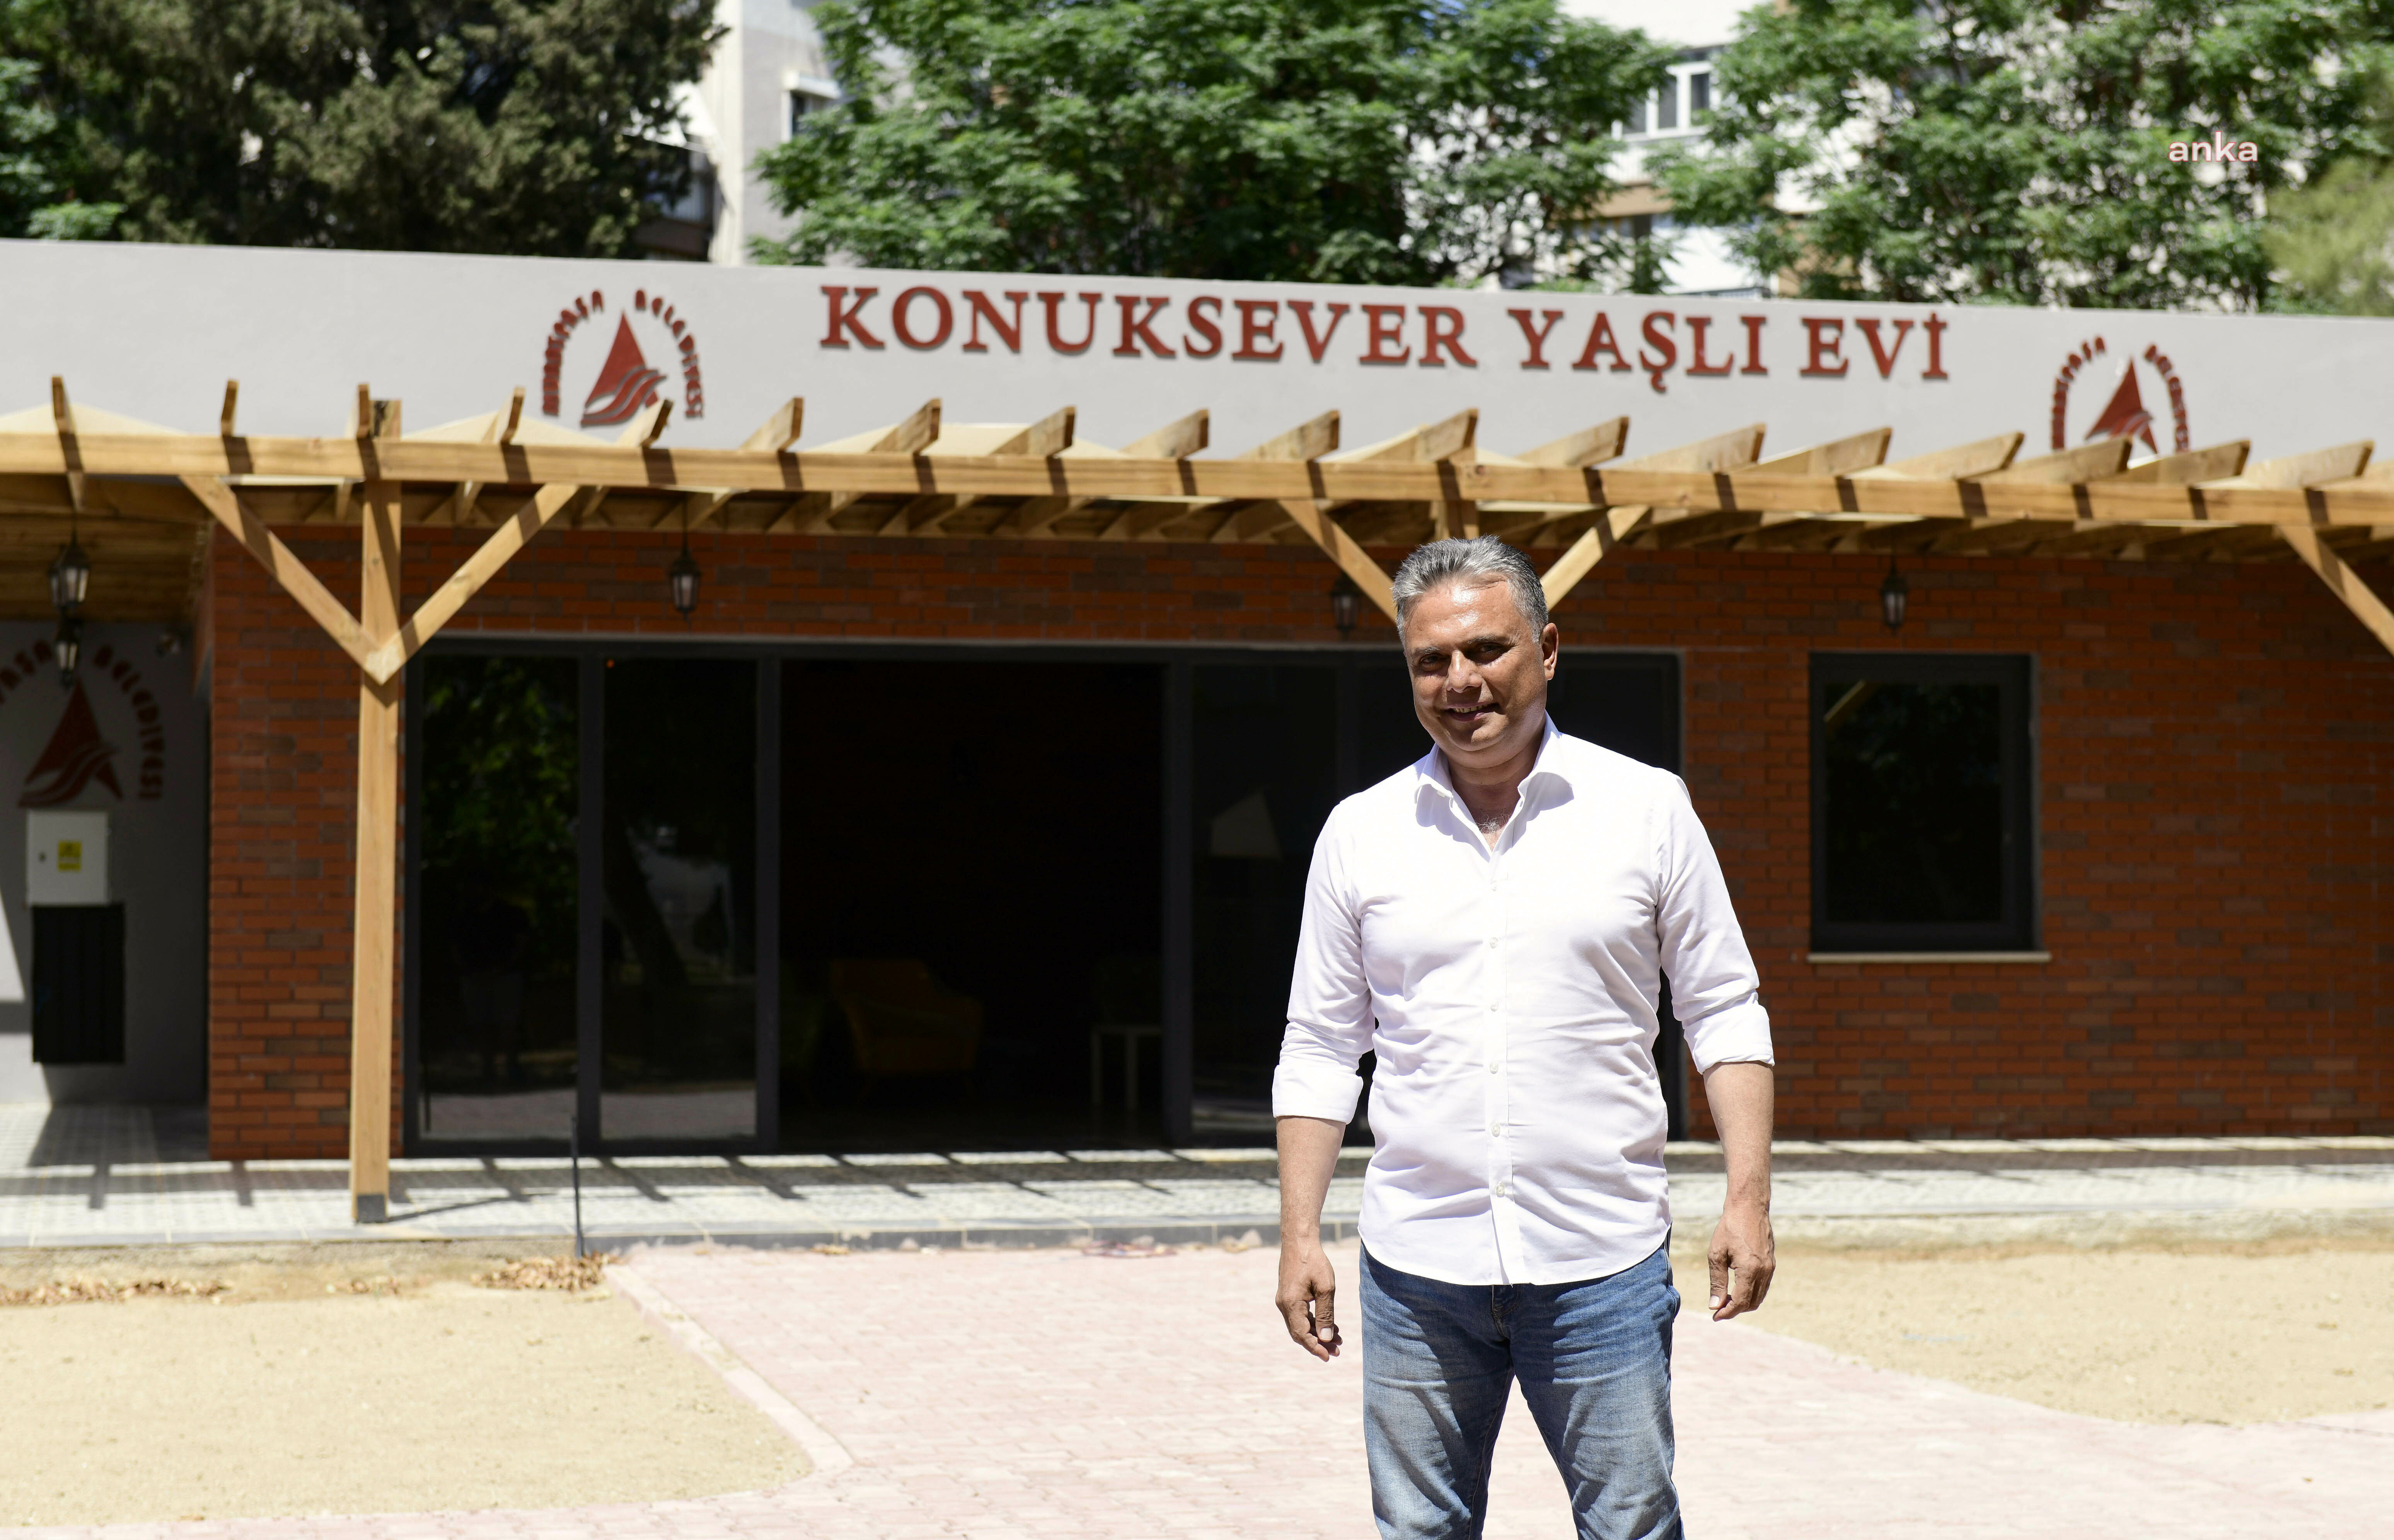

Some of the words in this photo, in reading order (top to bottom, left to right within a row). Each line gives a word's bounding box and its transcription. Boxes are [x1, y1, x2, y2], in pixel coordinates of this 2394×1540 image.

[820, 284, 1478, 367] KONUKSEVER
[1507, 308, 1768, 392] YAŞLI
[1800, 312, 1949, 380] EVİ
